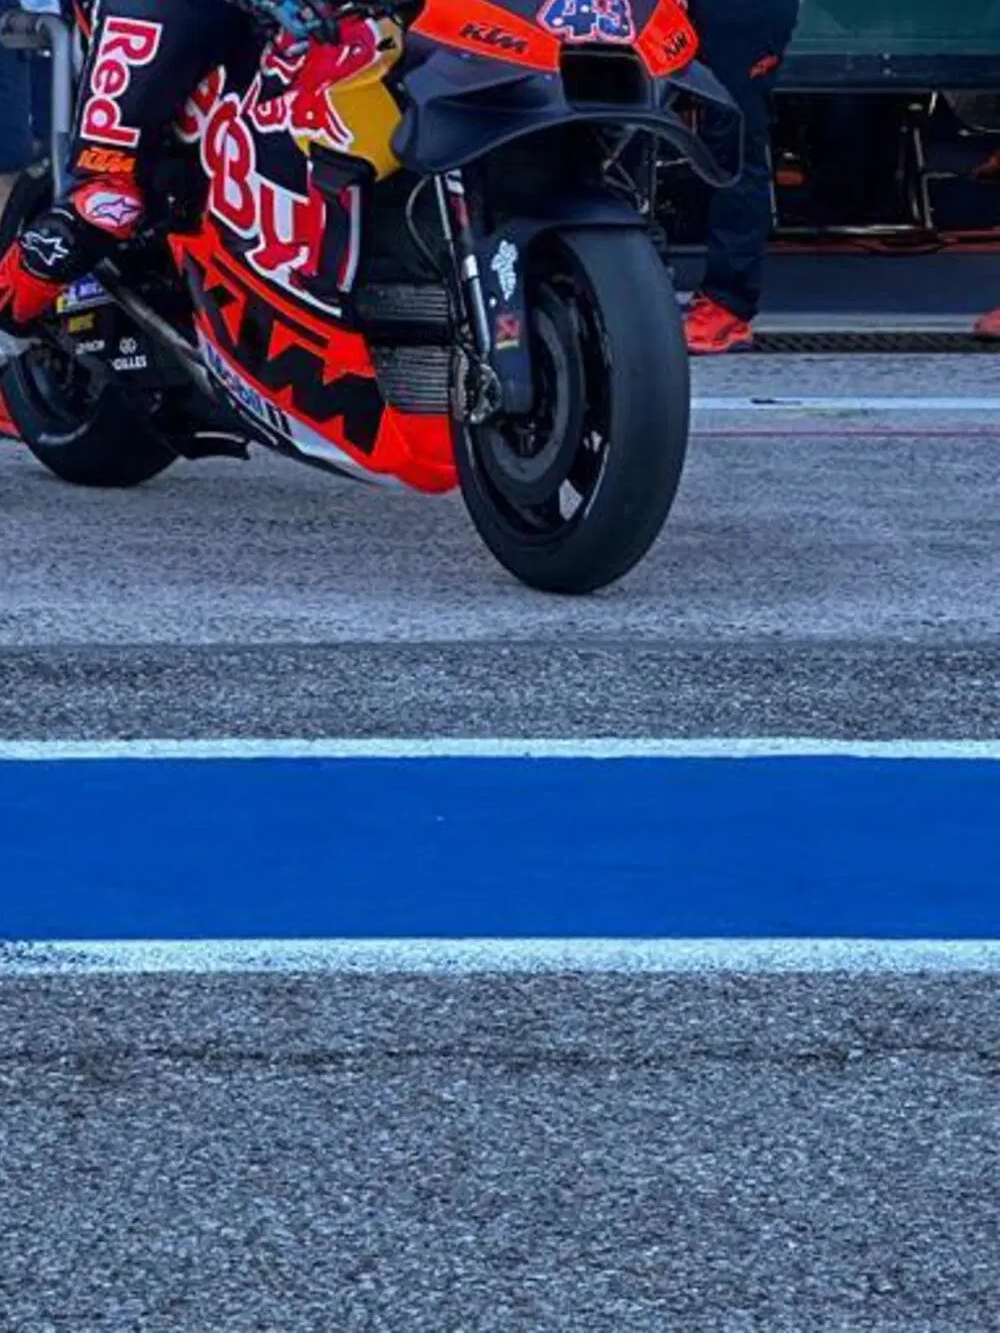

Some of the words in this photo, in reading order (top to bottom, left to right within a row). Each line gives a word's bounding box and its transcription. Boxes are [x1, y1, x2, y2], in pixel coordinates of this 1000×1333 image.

[80, 15, 164, 148] Red
[459, 21, 529, 55] KTM
[182, 252, 386, 456] KTM
